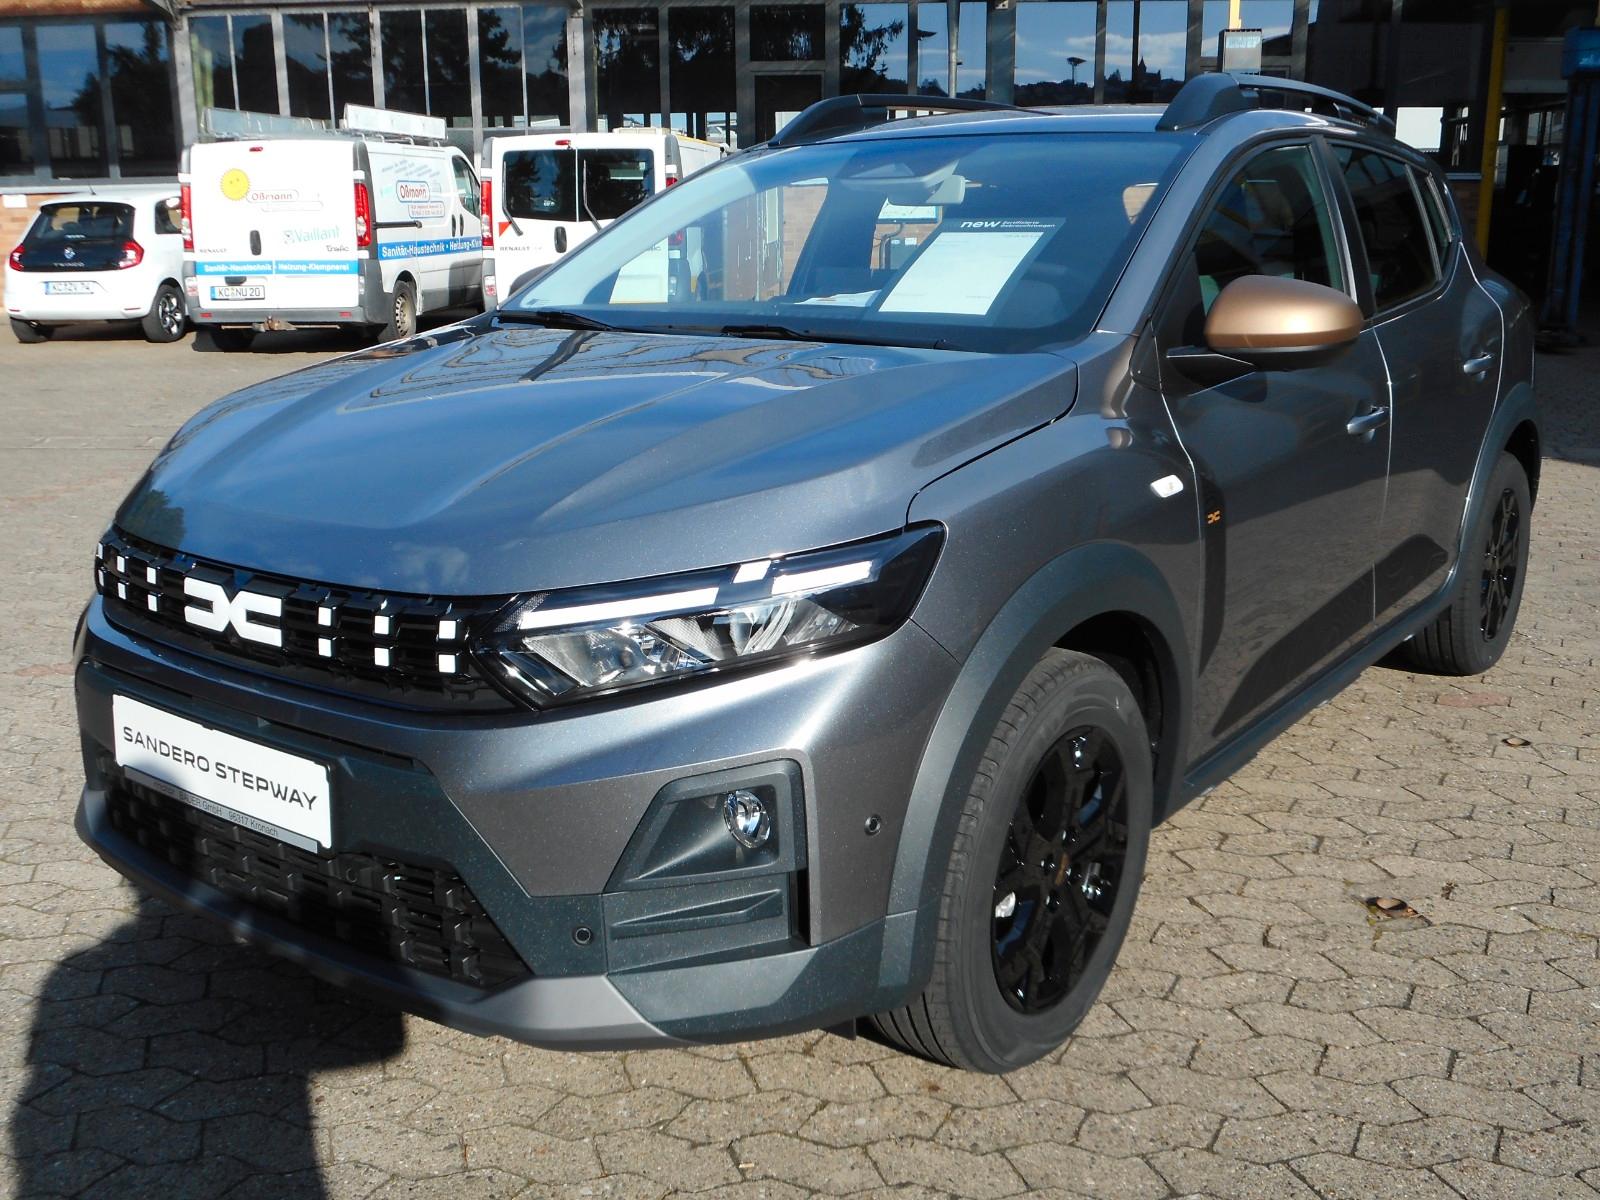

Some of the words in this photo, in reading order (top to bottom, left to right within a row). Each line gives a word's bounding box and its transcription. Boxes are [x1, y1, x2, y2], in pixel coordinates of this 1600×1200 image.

[294, 226, 340, 243] Vaillant
[218, 287, 230, 297] KC
[235, 287, 247, 297] NU
[249, 287, 261, 297] 20
[123, 726, 210, 773] SANDERO
[215, 761, 318, 811] STEPWAY
[202, 801, 222, 817] GmbH
[250, 818, 280, 837] Kronach
